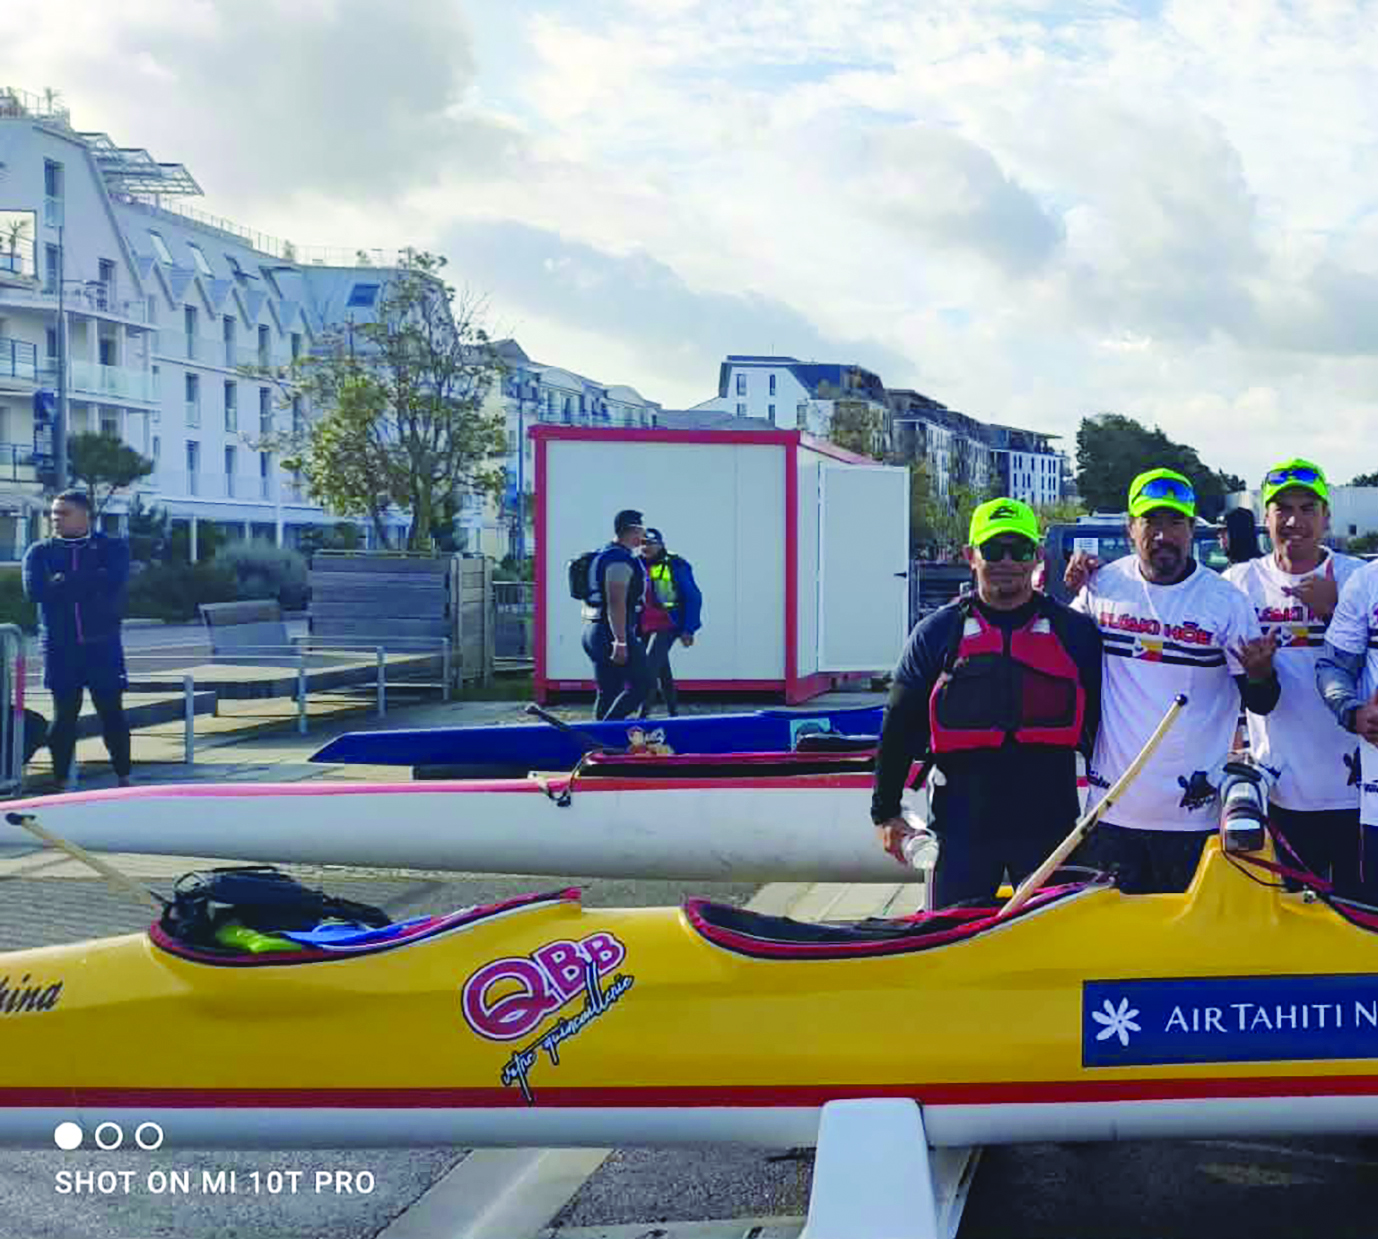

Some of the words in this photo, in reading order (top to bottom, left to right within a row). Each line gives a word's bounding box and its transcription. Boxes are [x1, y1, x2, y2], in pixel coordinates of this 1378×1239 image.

[461, 931, 626, 1041] QBB
[1164, 1004, 1228, 1033] AIR
[1230, 1002, 1343, 1032] TAHITI
